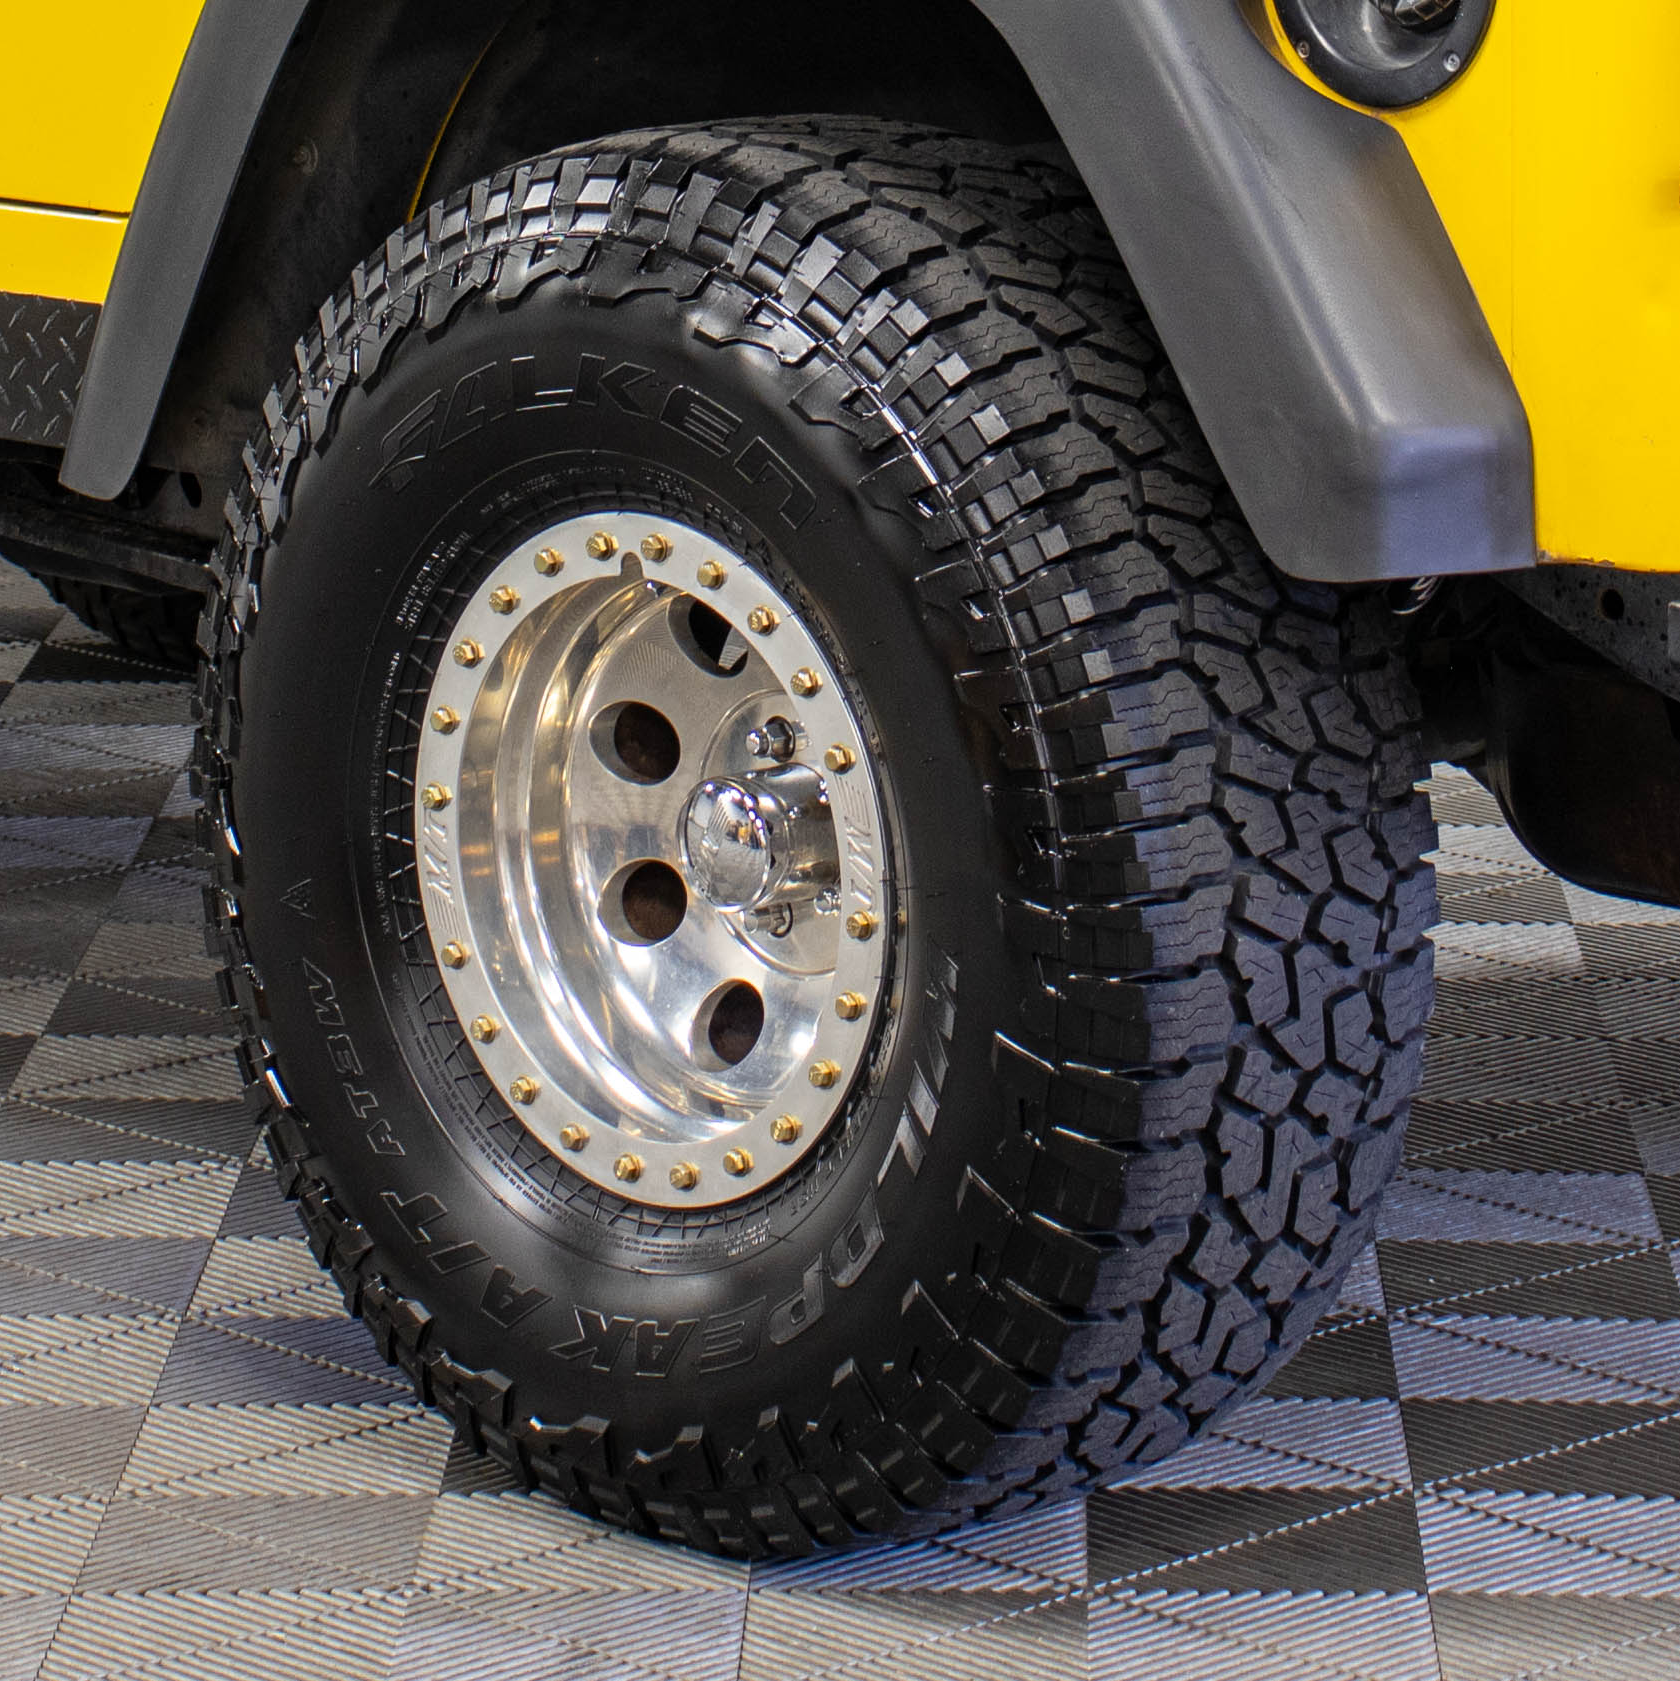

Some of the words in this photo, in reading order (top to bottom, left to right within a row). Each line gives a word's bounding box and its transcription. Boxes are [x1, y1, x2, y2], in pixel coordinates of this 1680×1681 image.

[368, 352, 817, 531] FALKEN
[302, 956, 407, 1157] AT3W
[548, 932, 960, 1378] WILDPEAK
